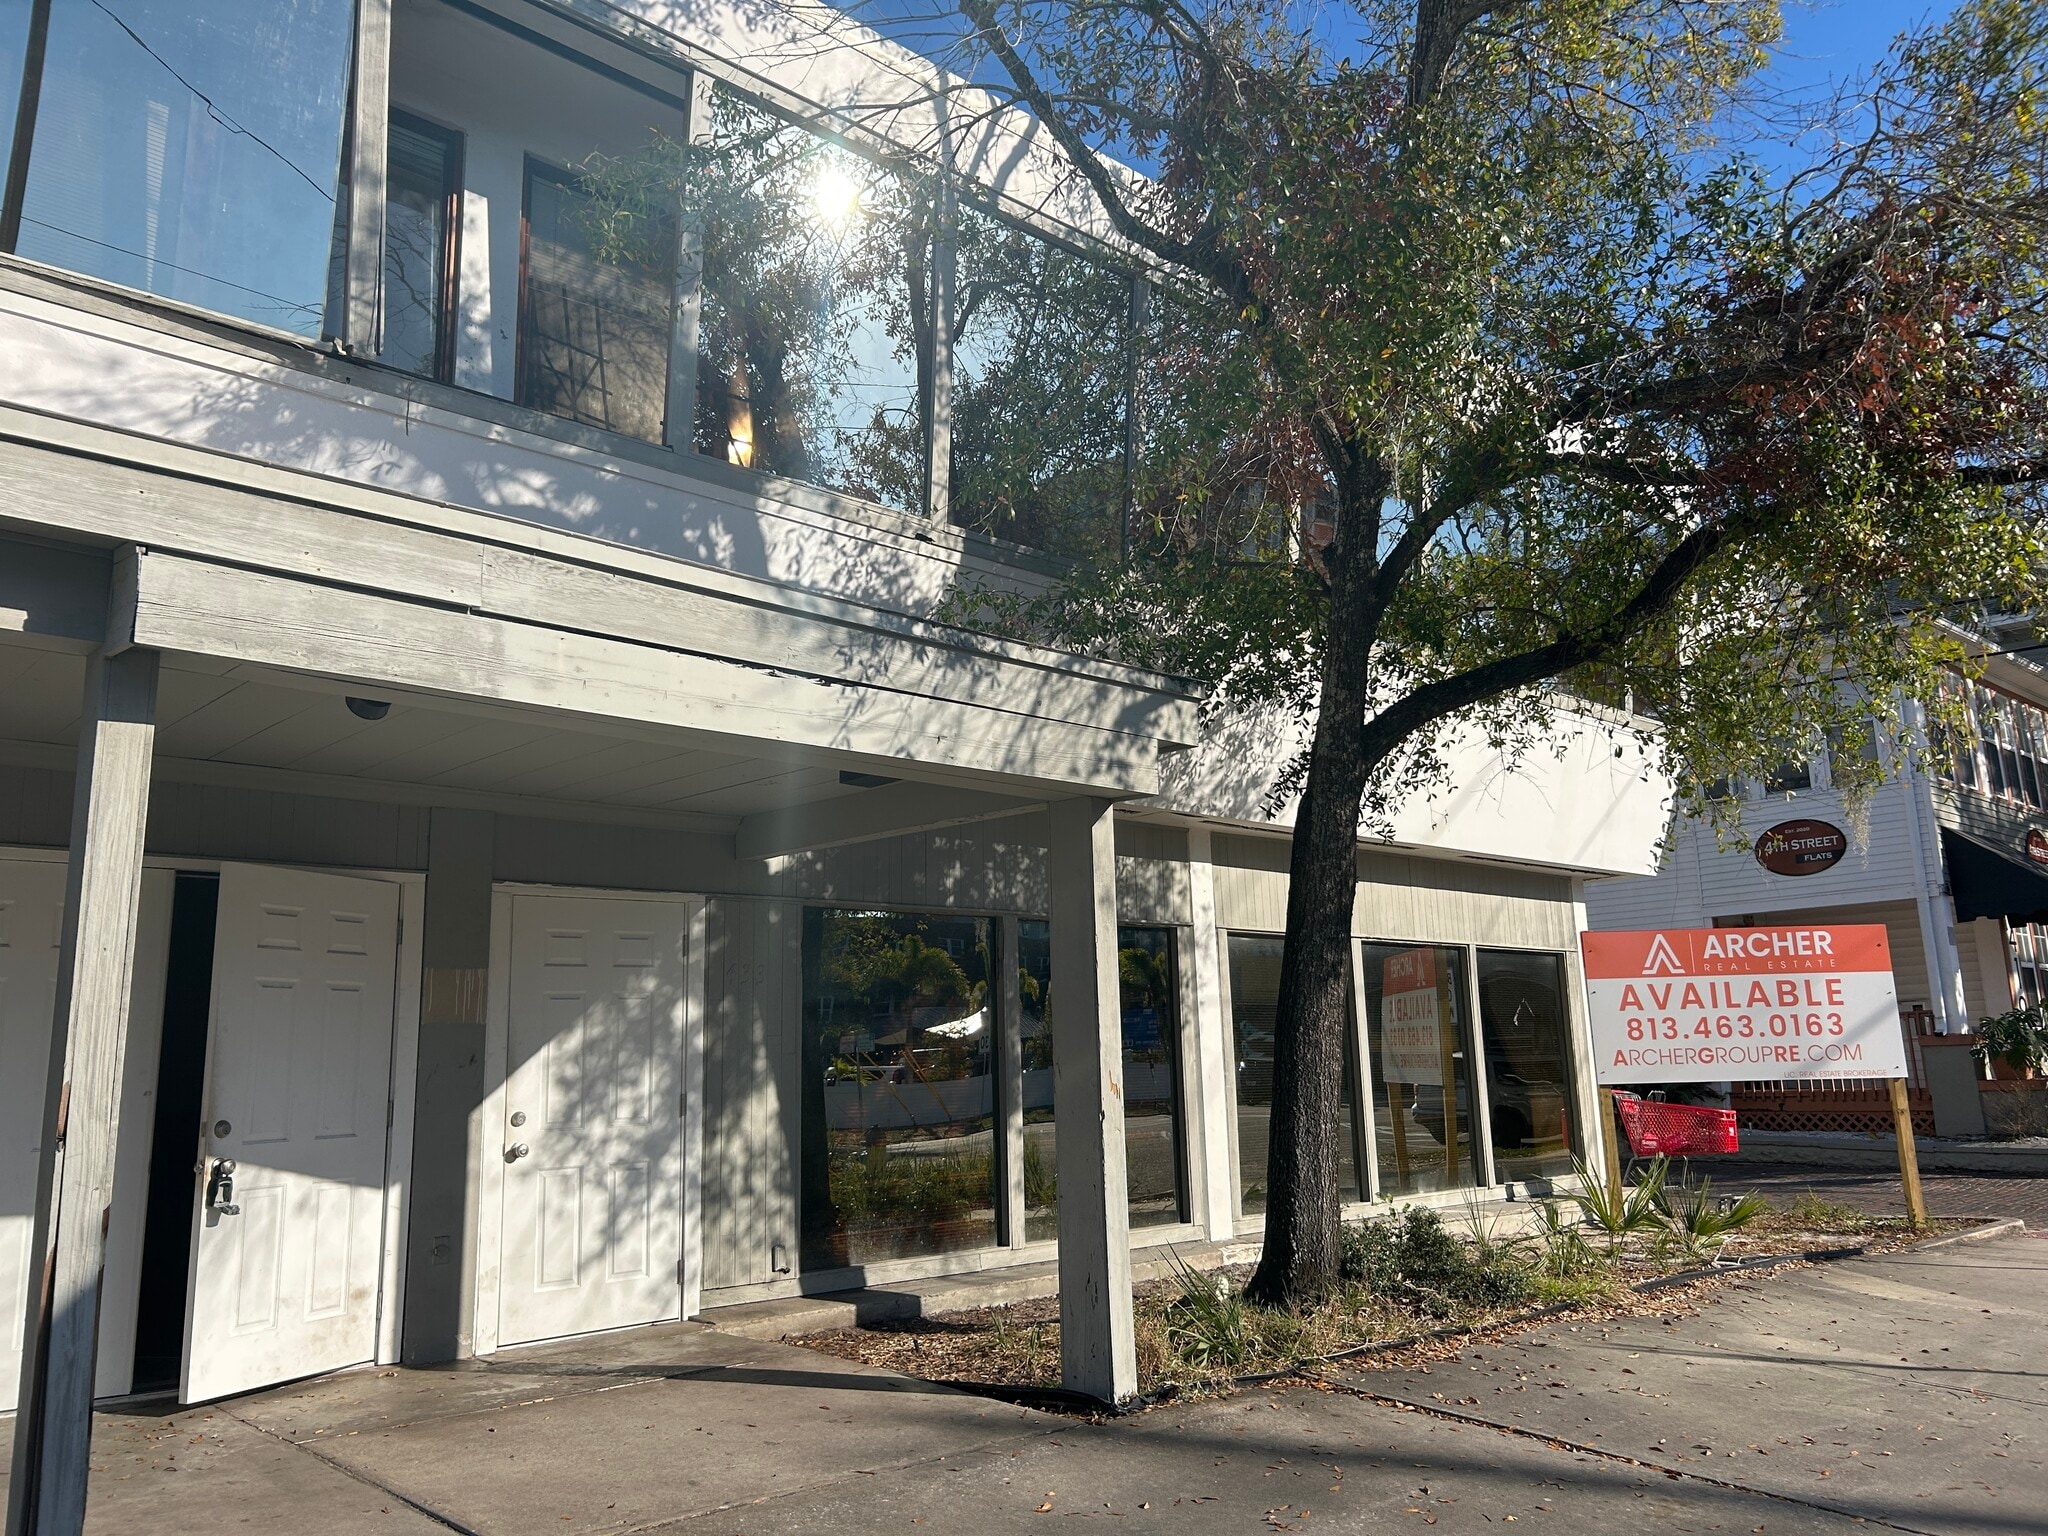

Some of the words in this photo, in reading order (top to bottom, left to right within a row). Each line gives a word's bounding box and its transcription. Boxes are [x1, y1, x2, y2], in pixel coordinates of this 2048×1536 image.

[1791, 835, 1839, 850] STREET
[1804, 852, 1833, 861] FLATS
[1703, 930, 1834, 959] ARCHER
[1703, 962, 1751, 972] REAL
[1768, 959, 1837, 970] ESTATE
[1618, 978, 1845, 1012] AVAILABLE
[1626, 1012, 1844, 1041] 813.463.0163
[1613, 1044, 1863, 1067] ARCHERGROUPRE.COM
[1799, 1070, 1817, 1078] REAL
[1843, 1069, 1887, 1077] BROKERAGE
